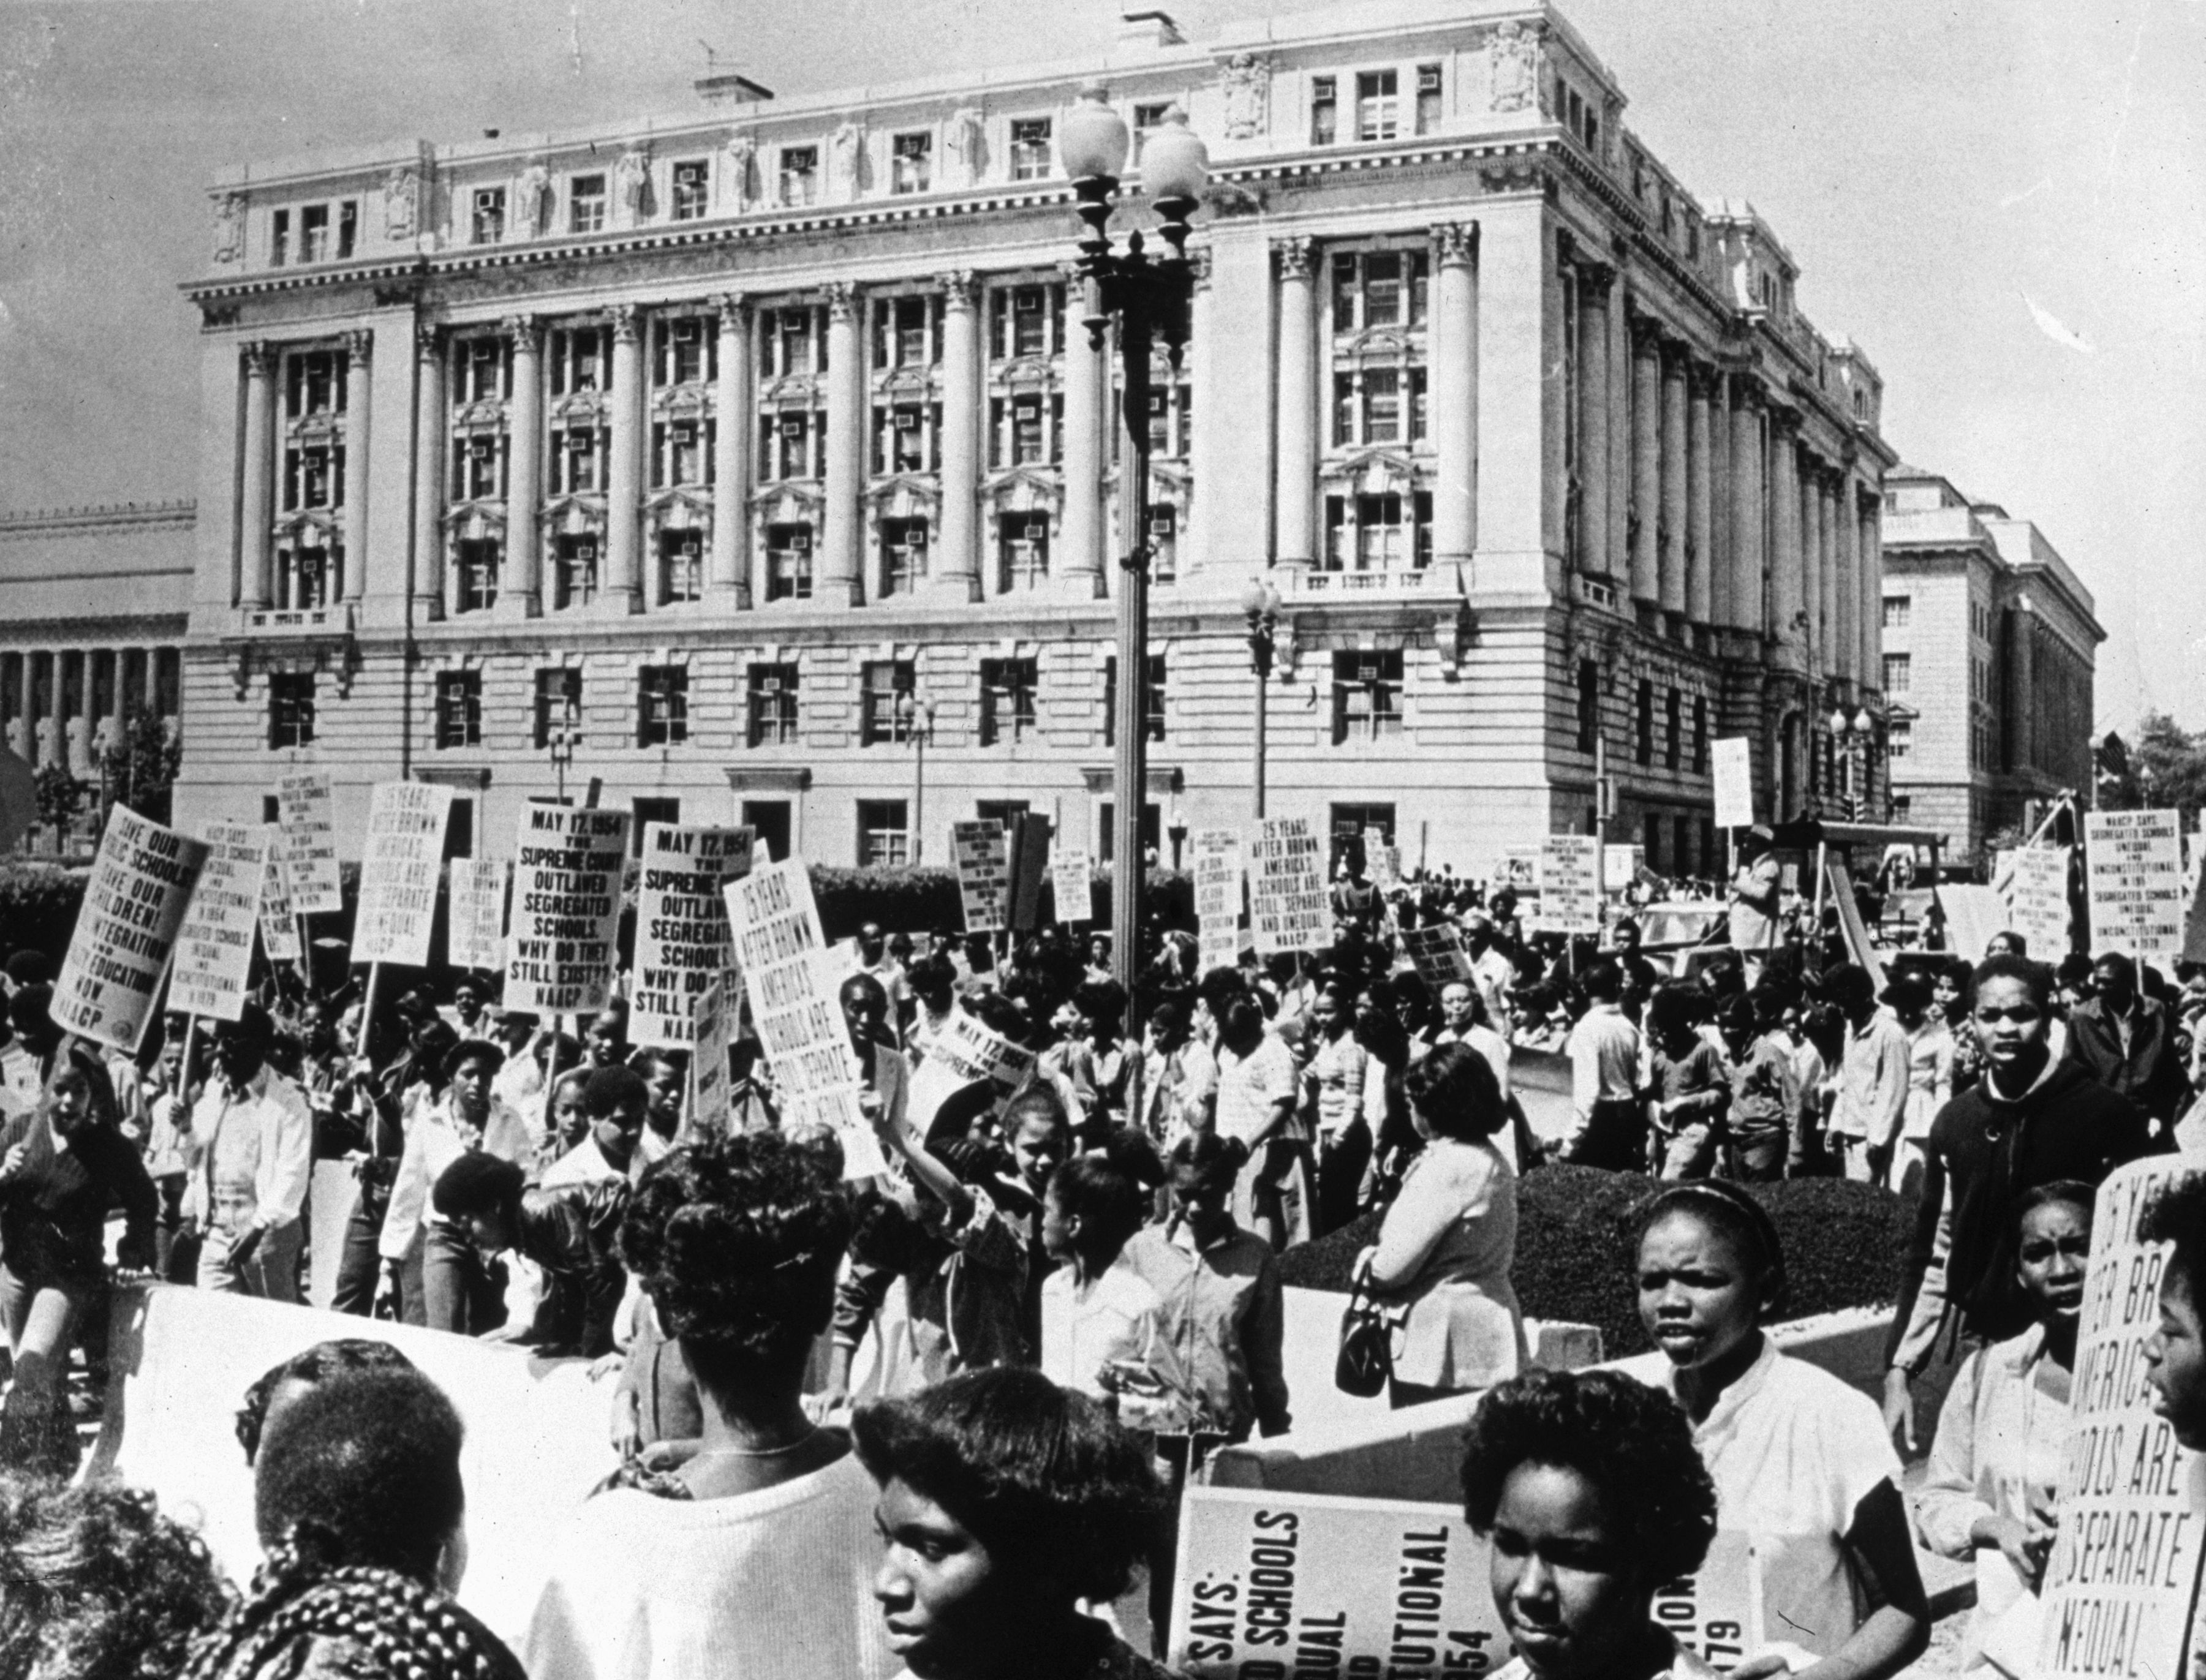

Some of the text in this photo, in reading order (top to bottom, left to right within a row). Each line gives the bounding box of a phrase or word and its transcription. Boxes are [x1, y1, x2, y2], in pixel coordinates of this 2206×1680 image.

[532, 810, 563, 831] MAY
[1279, 818, 1307, 837] YEARS
[2142, 826, 2175, 838] SCHOOLS
[148, 829, 180, 859] OUR
[565, 836, 591, 848] THE
[657, 831, 693, 854] MAY
[1287, 837, 1318, 856] BROWN
[521, 846, 622, 872] SUPREME COURT
[695, 859, 723, 872] THE
[130, 876, 165, 908] OUR
[534, 872, 606, 894] OUTLAWED
[646, 869, 716, 895] SUPREME
[1258, 873, 1320, 895] SCHOOLS ARE
[2145, 889, 2177, 900] SCHOOLS
[524, 892, 611, 917] SEGREGATED
[662, 895, 727, 920] OUTLAW
[90, 911, 169, 965] NTEGRATION
[769, 910, 816, 960] BROWN
[518, 939, 608, 962] WHY DO THEY
[88, 950, 156, 1000] EDUCATION
[510, 961, 551, 984] STILL
[644, 968, 678, 991] WHY
[685, 971, 706, 993] DO
[74, 973, 103, 1003] NOW
[535, 987, 581, 1008] NAACP
[636, 991, 680, 1016] STILL
[663, 1019, 693, 1041] NAA
[957, 1021, 981, 1045] MAY
[2129, 1423, 2181, 1495] ARE
[2068, 1512, 2191, 1588] SEPARATE
[1244, 1510, 1298, 1646] SCHOOLS
[1187, 1571, 1240, 1661] SAYS:
[1294, 1611, 1346, 1680] QUAL
[2054, 1599, 2143, 1679] NEQUAL
